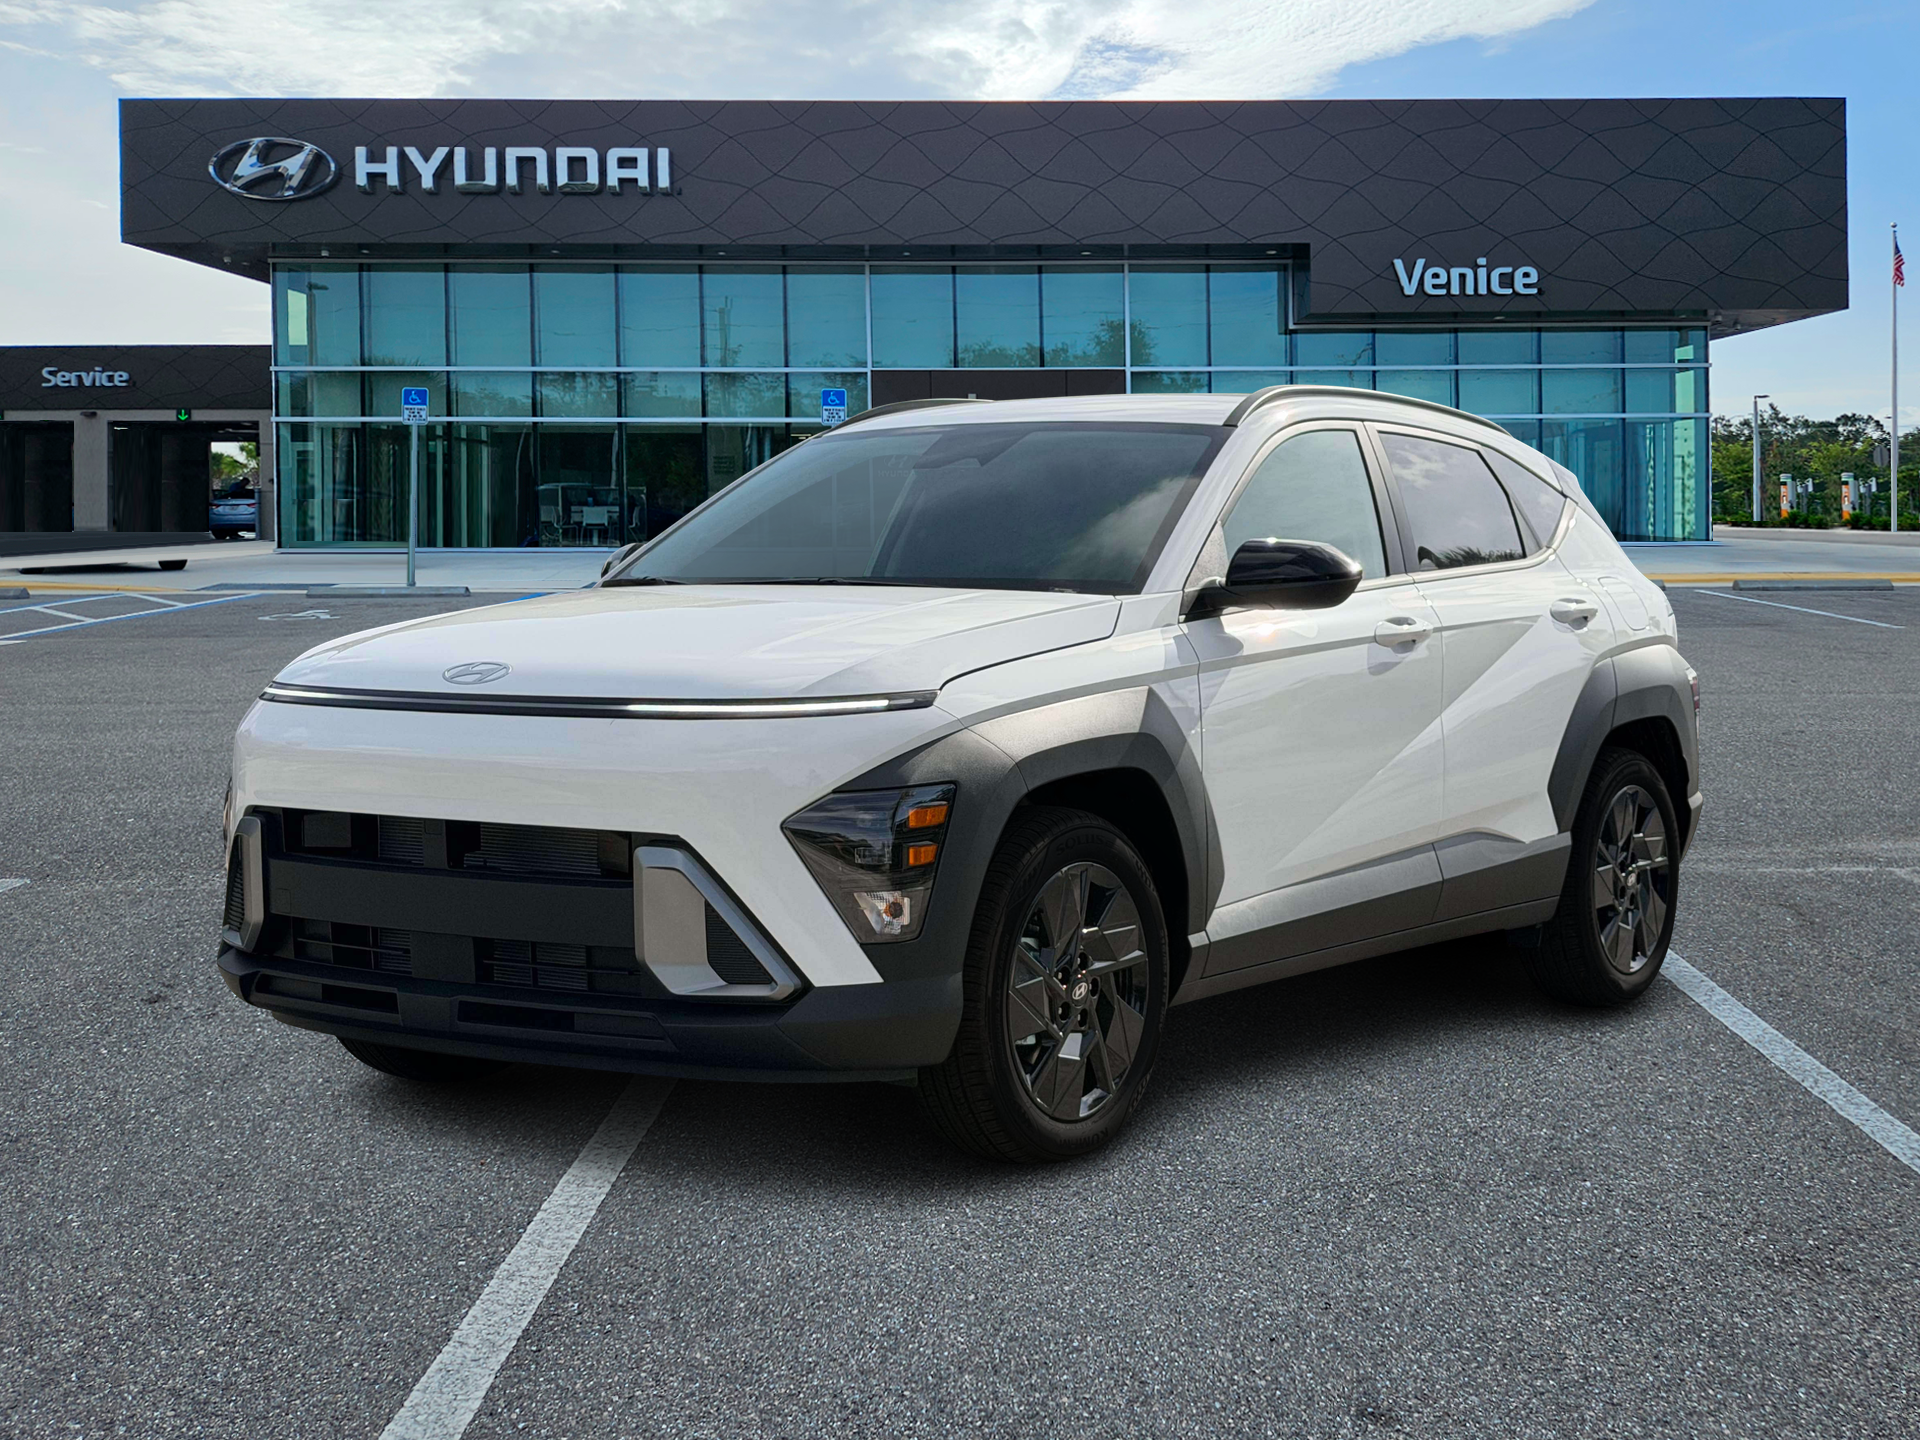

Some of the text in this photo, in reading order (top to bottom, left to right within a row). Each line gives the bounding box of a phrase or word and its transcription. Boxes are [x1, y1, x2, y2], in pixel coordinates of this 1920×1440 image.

[354, 146, 671, 194] HYUNDAI
[1393, 257, 1538, 295] Venice
[41, 366, 130, 387] Service
